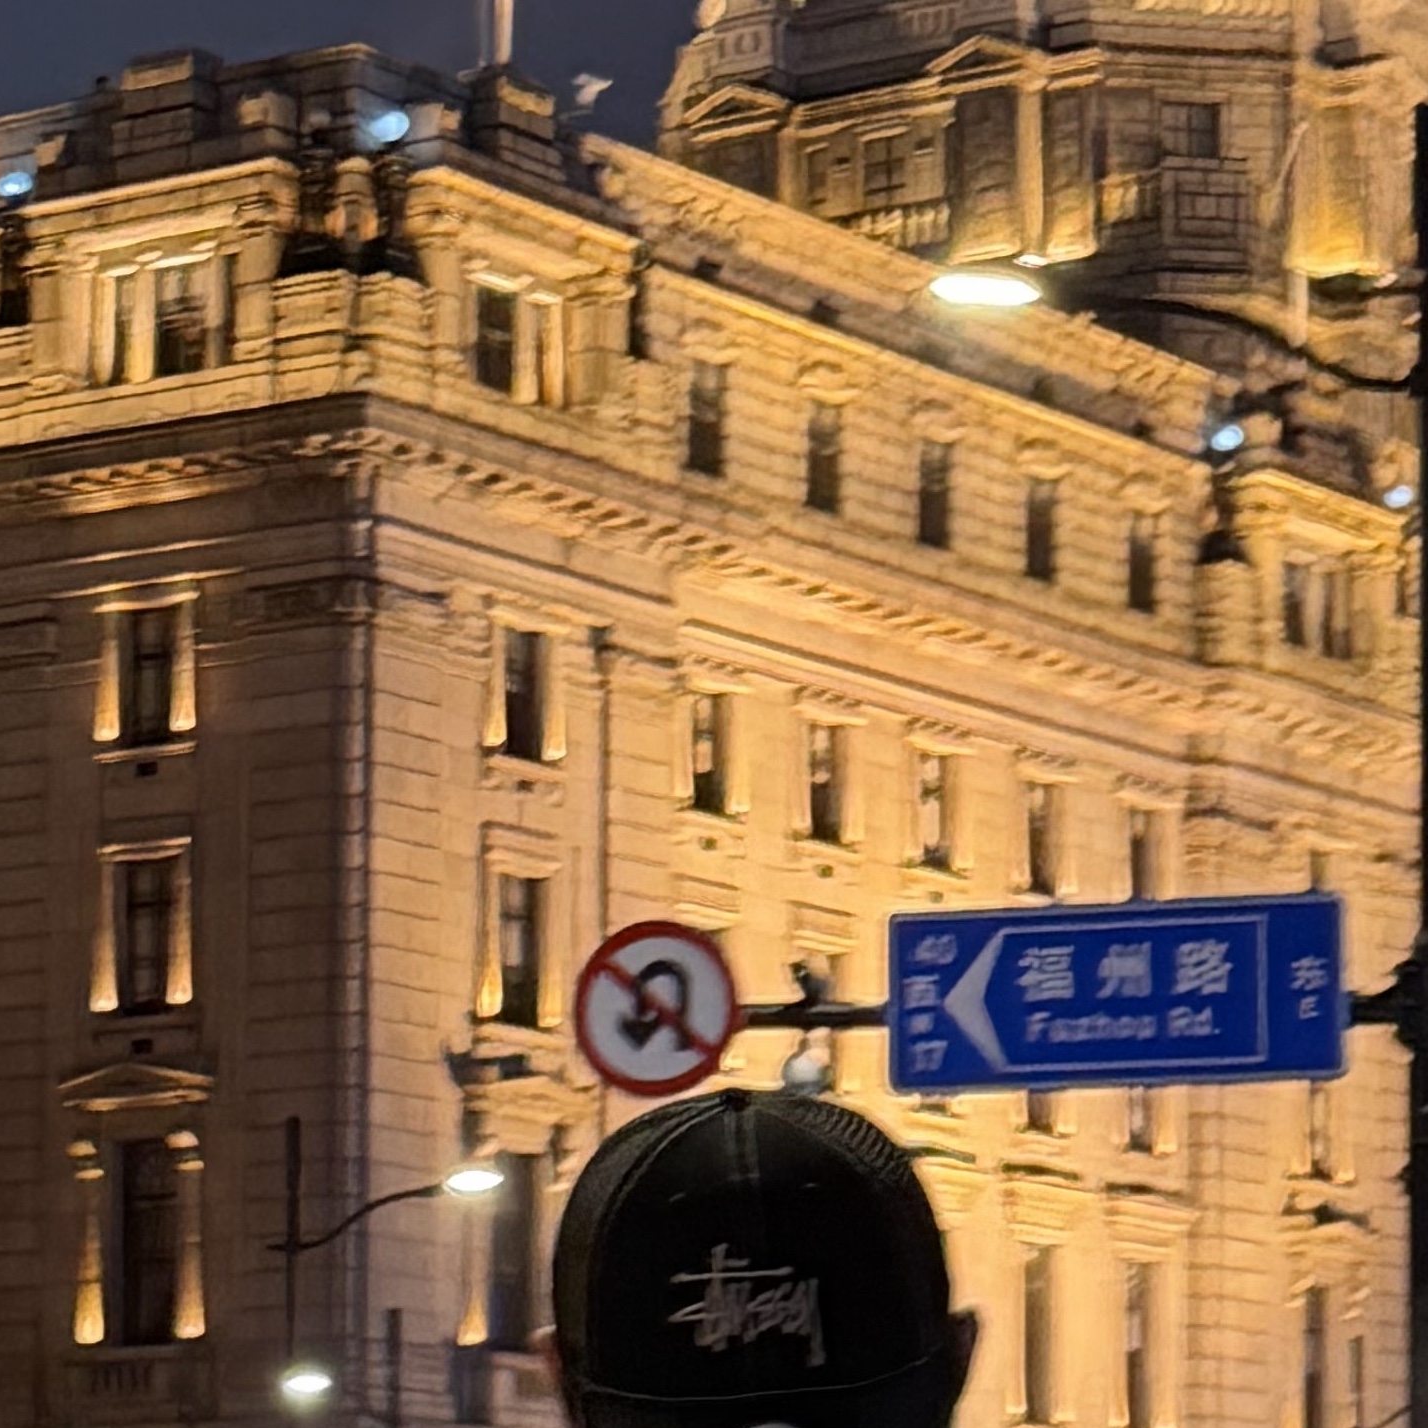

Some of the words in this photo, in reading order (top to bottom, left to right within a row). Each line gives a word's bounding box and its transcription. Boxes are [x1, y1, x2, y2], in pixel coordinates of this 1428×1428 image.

[1015, 938, 1234, 1003] 福州路
[1298, 995, 1320, 1020] E
